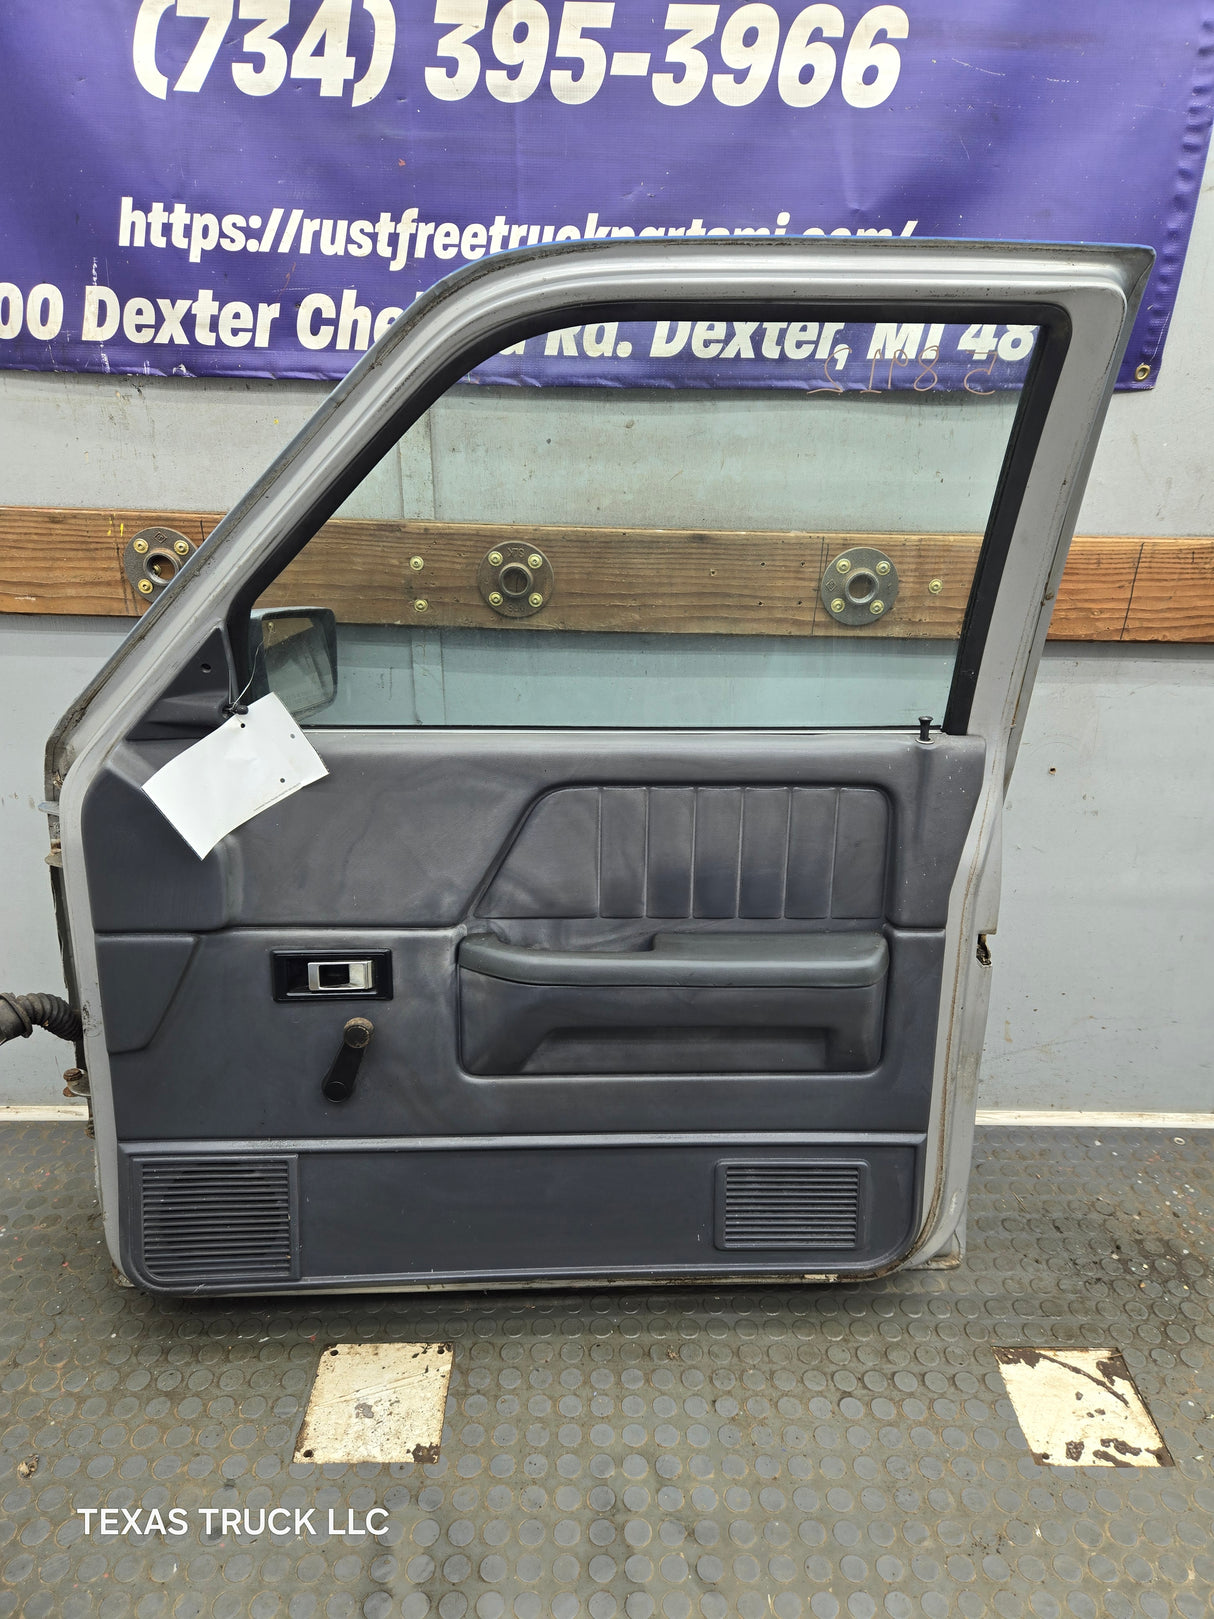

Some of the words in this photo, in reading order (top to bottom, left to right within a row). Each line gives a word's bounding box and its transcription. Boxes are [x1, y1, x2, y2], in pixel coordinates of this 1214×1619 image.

[132, 0, 397, 108] (734)
[424, 0, 910, 109] 395-3966
[119, 197, 919, 272] https://rustfreetr
[82, 285, 282, 348] Dexter
[649, 321, 849, 371] Dexter,
[866, 322, 946, 360] MI
